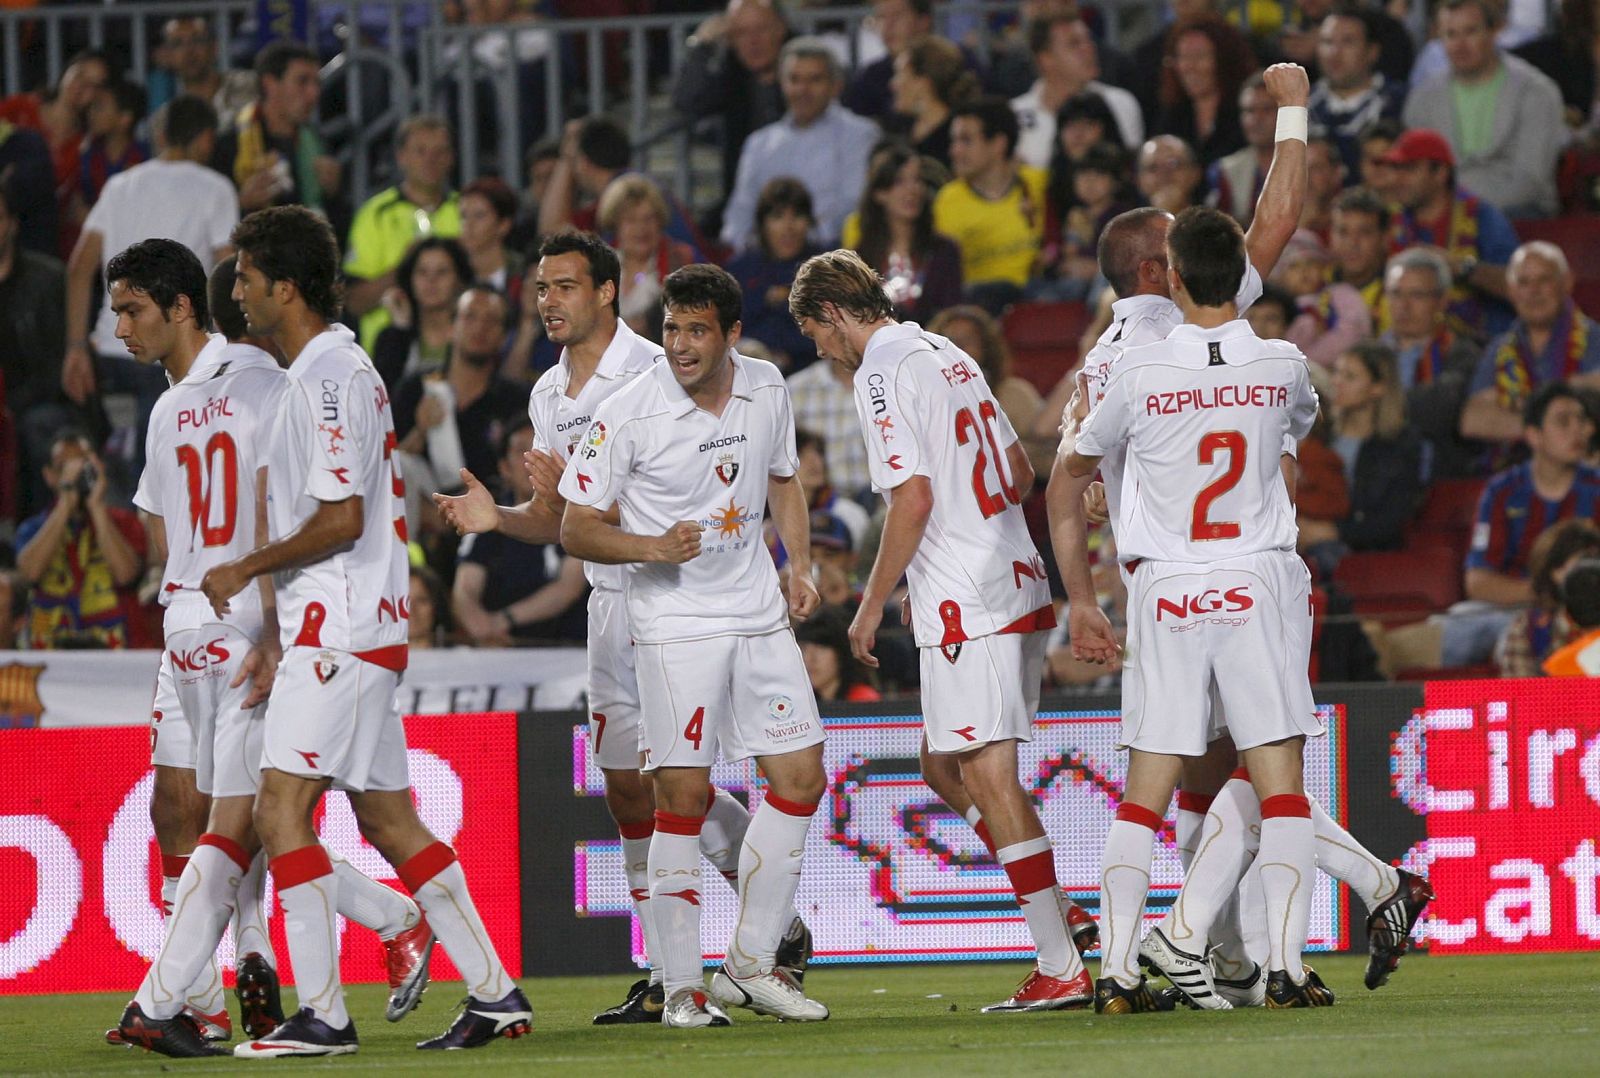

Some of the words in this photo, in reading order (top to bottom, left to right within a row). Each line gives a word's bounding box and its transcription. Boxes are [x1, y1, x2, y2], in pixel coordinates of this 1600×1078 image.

[322, 379, 339, 421] can
[868, 373, 887, 415] can
[1146, 385, 1288, 416] AZPILICUETA
[698, 434, 748, 453] DIADORA
[955, 399, 1021, 521] 20
[174, 430, 239, 553] 10
[1190, 430, 1248, 542] 2
[1156, 586, 1254, 622] NGS
[1170, 616, 1250, 633] technology
[169, 637, 231, 673] NGS
[592, 711, 607, 754] 7
[684, 706, 705, 750] 4
[765, 721, 810, 739] Navarra
[1174, 959, 1194, 968] RIFLE
